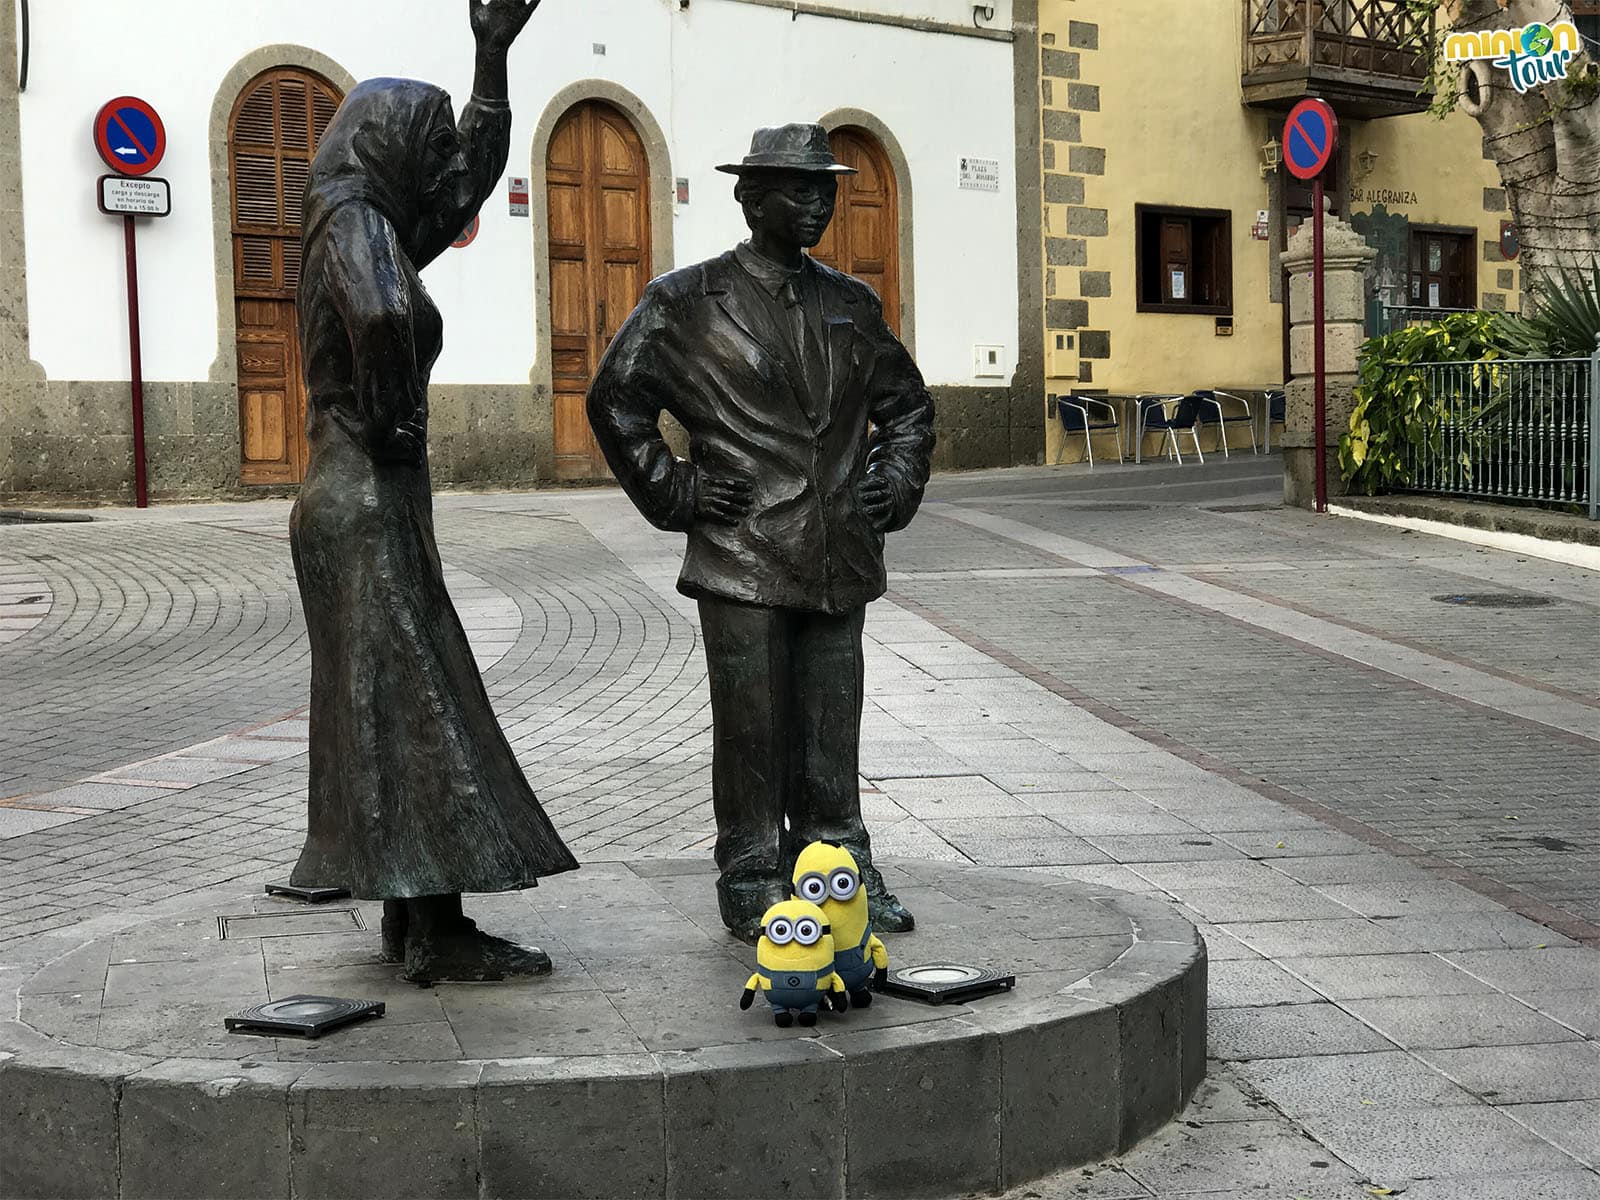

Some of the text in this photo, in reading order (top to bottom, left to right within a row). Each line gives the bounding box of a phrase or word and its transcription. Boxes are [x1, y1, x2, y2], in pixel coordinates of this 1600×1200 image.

[121, 180, 150, 189] Excepto
[1350, 188, 1418, 205] BAR ALEGRANZA
